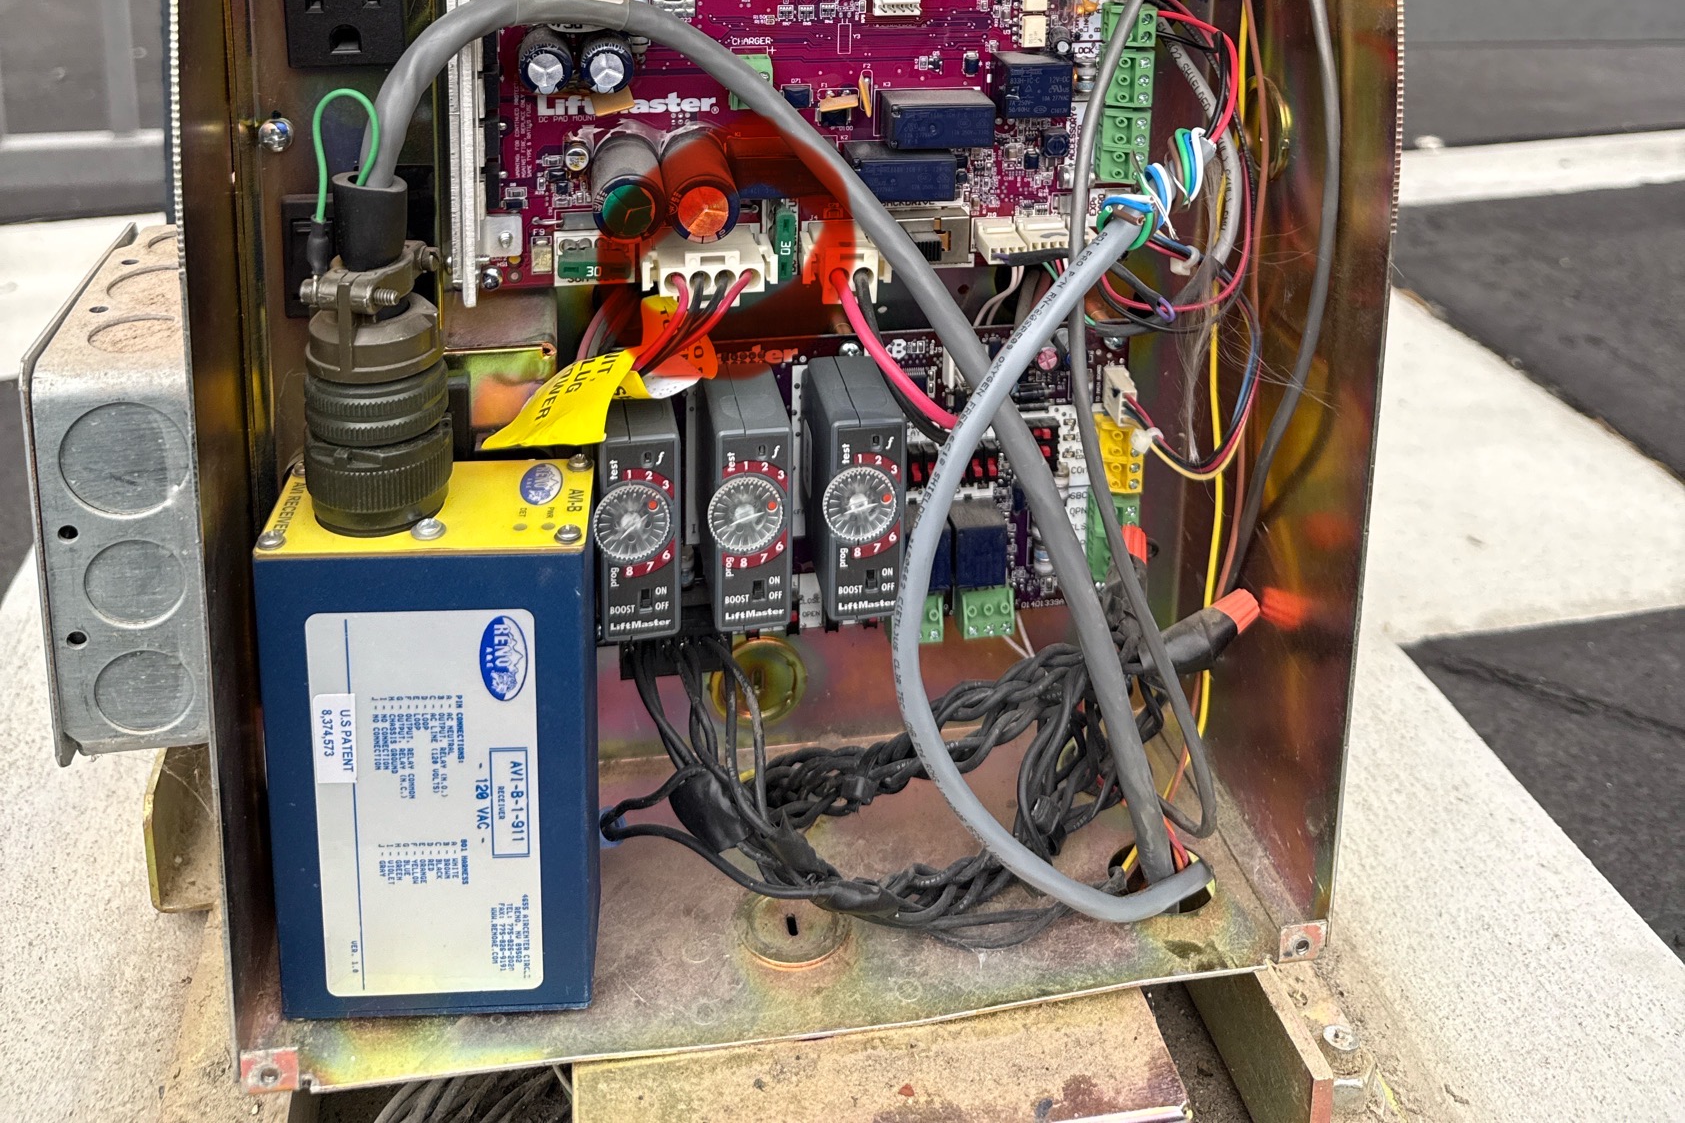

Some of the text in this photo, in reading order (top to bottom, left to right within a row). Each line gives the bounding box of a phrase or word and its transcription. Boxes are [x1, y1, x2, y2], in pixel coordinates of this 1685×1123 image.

[1069, 112, 1078, 161] ACCESSORY
[780, 240, 791, 255] 30
[586, 265, 602, 277] 30
[977, 356, 1005, 397] OXYGEN
[727, 452, 735, 471] test
[842, 444, 850, 464] test
[858, 454, 898, 474] 1 2 3
[610, 460, 618, 480] test
[627, 470, 669, 489] 1 2 3
[744, 461, 785, 479] 1 2 3
[567, 489, 584, 512] AVI-B
[854, 532, 897, 557] 8 7 6
[626, 550, 671, 576] 8 7 6
[740, 542, 783, 568] 8 7 6
[840, 548, 848, 567] prog
[611, 567, 619, 587] prog
[726, 557, 734, 577] prog
[882, 567, 893, 576] ON
[769, 576, 780, 584] ON
[838, 583, 895, 594] BOOST OFF
[655, 586, 667, 595] ON
[725, 591, 783, 604] BOOST OFF
[610, 601, 669, 614] BOOST OFF
[725, 608, 784, 620] LiftMaster
[838, 599, 896, 611] LiftMaster
[610, 619, 671, 631] LiftMaster
[494, 624, 512, 666] RENO
[389, 714, 397, 744] CHASSIS
[413, 713, 421, 730] LOOP
[320, 710, 334, 757] 8,374,573
[340, 710, 353, 772] U.S PATENT
[456, 712, 464, 763] CONNECTIONS:
[373, 727, 381, 770] CONNECTION
[381, 727, 390, 770] CONNECTION
[475, 778, 490, 829] 120 VAC
[510, 761, 525, 841] AVI-B-1-911
[522, 915, 530, 950] AIRCENTER
